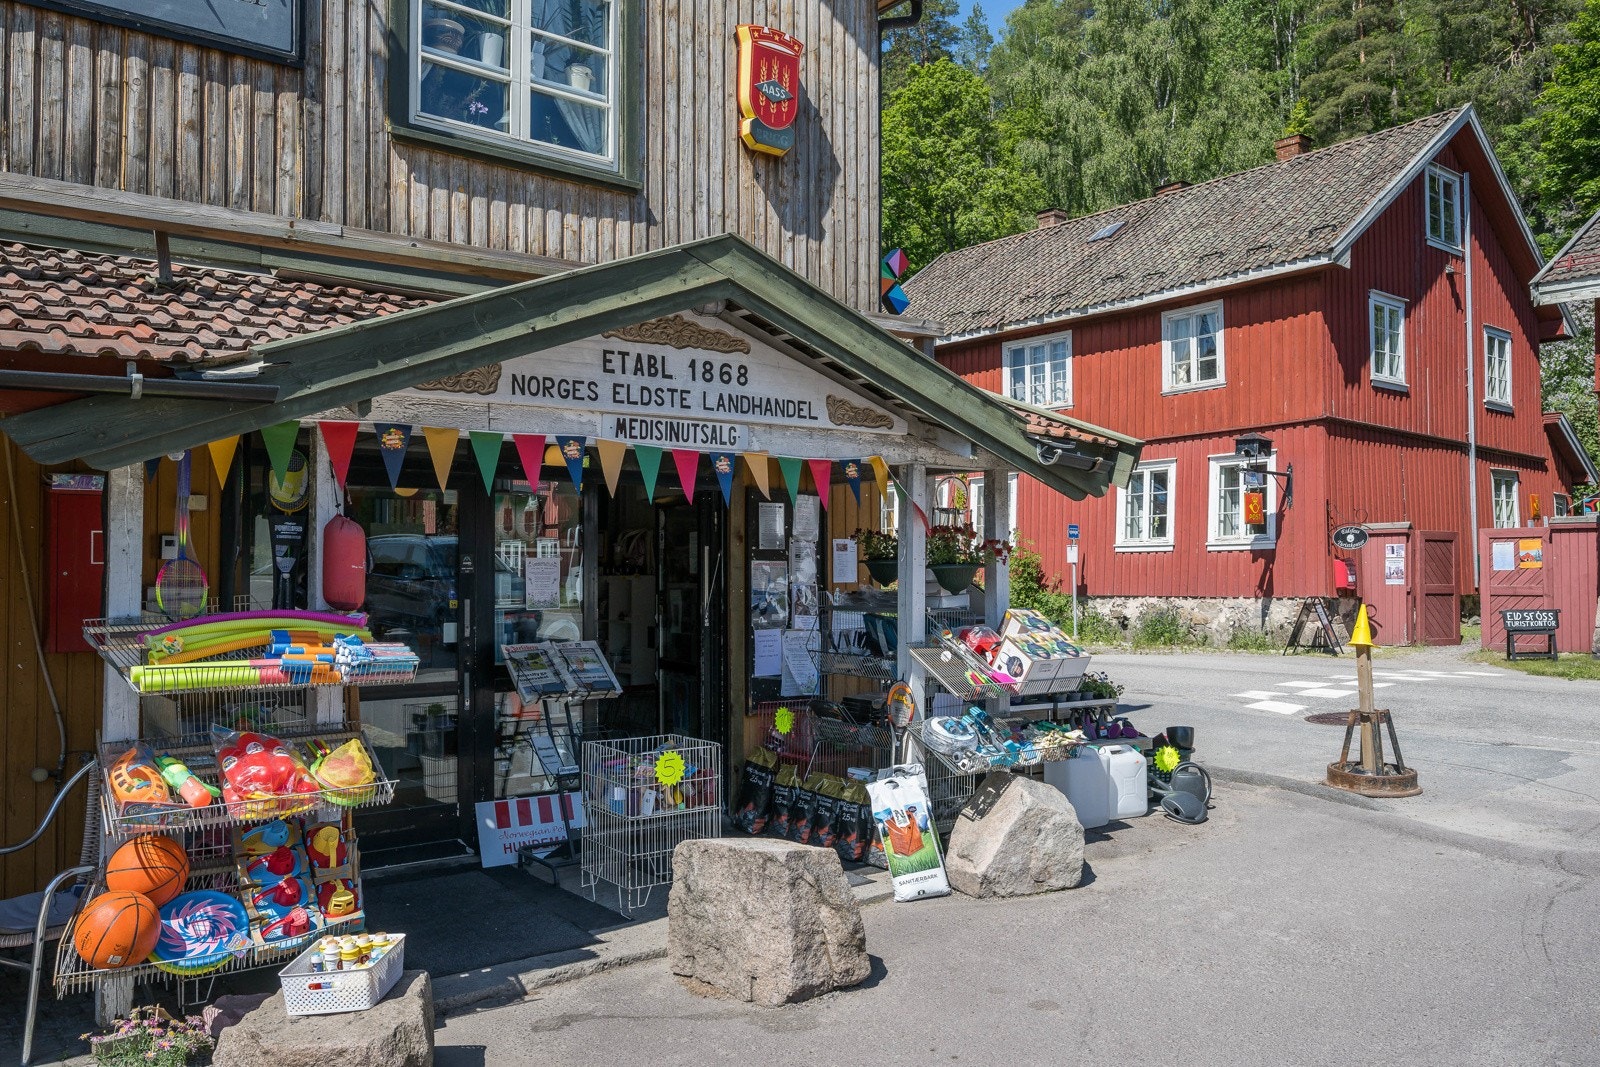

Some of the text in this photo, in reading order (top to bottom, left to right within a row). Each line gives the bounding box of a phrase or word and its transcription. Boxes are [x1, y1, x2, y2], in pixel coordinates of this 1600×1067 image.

[762, 83, 786, 99] AASS
[688, 358, 749, 387] 1868
[511, 373, 819, 421] NORGES ELDSTE LANDHANDEL
[499, 828, 552, 841] Norwegian
[503, 835, 568, 855] HUNDEMA
